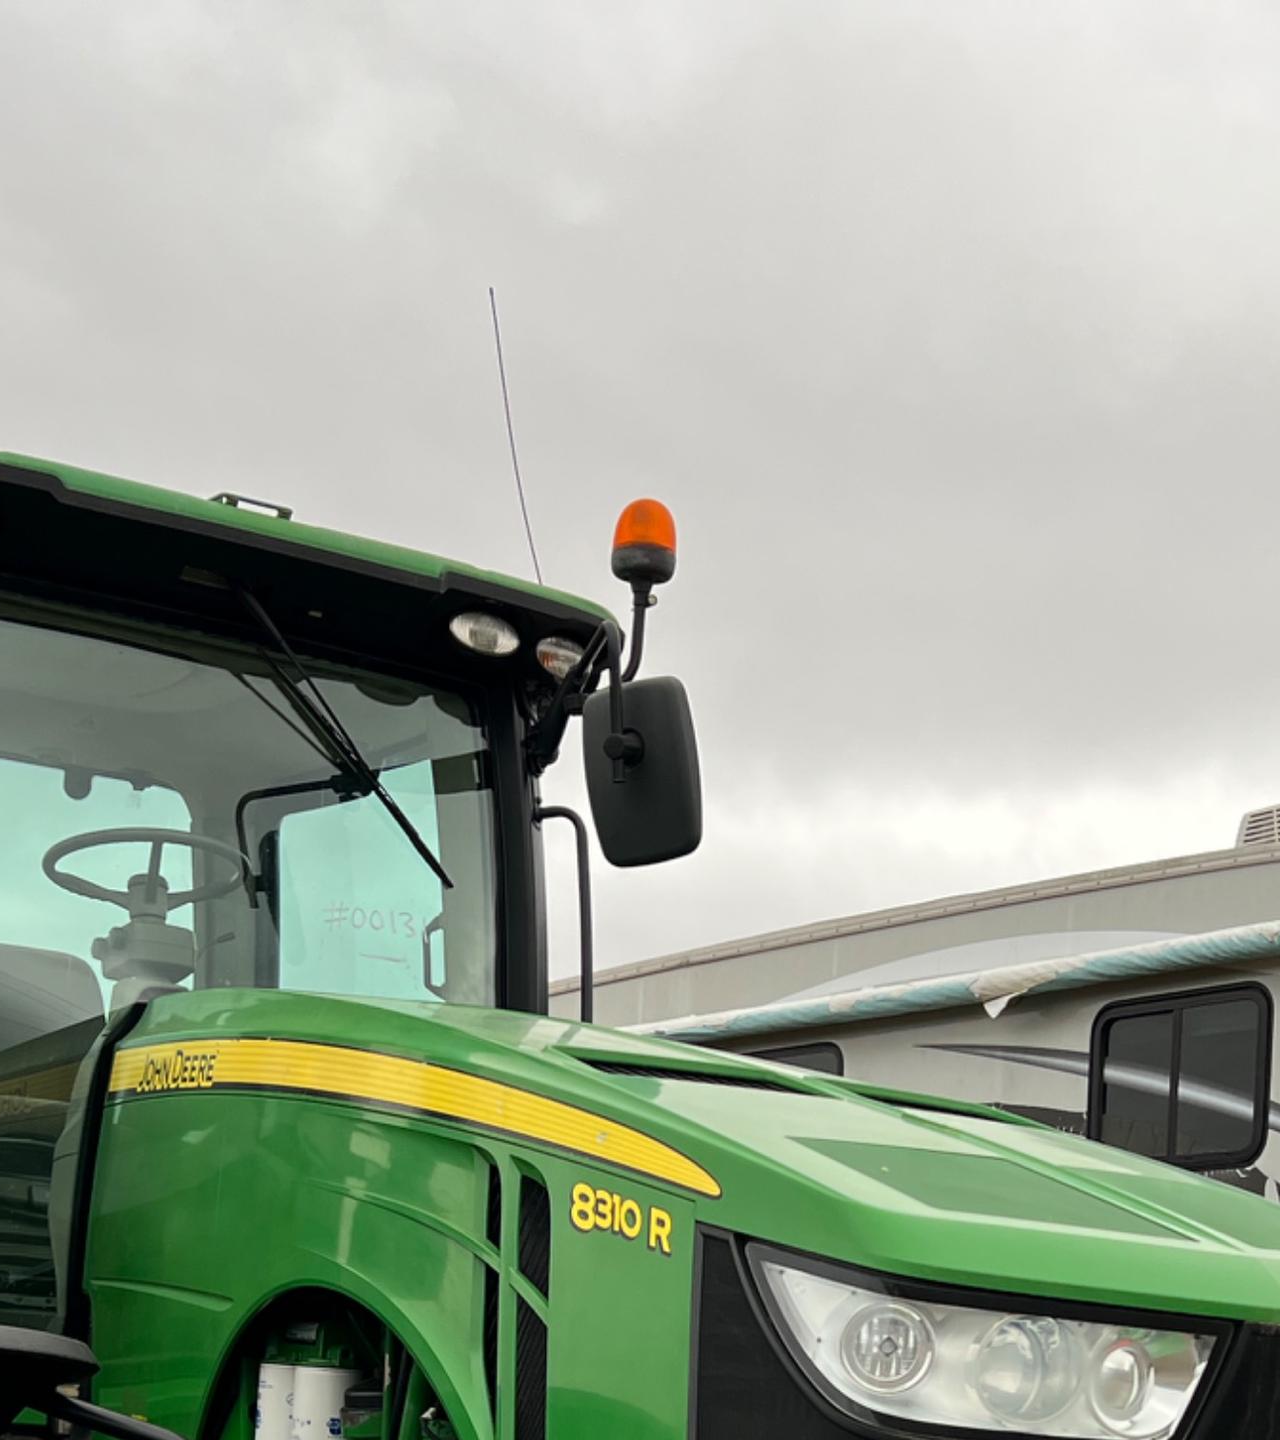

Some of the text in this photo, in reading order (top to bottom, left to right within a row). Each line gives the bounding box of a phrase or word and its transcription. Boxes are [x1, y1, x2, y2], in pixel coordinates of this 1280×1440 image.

[137, 1049, 216, 1091] JOHN DEERE
[571, 1182, 672, 1256] 8310 R
